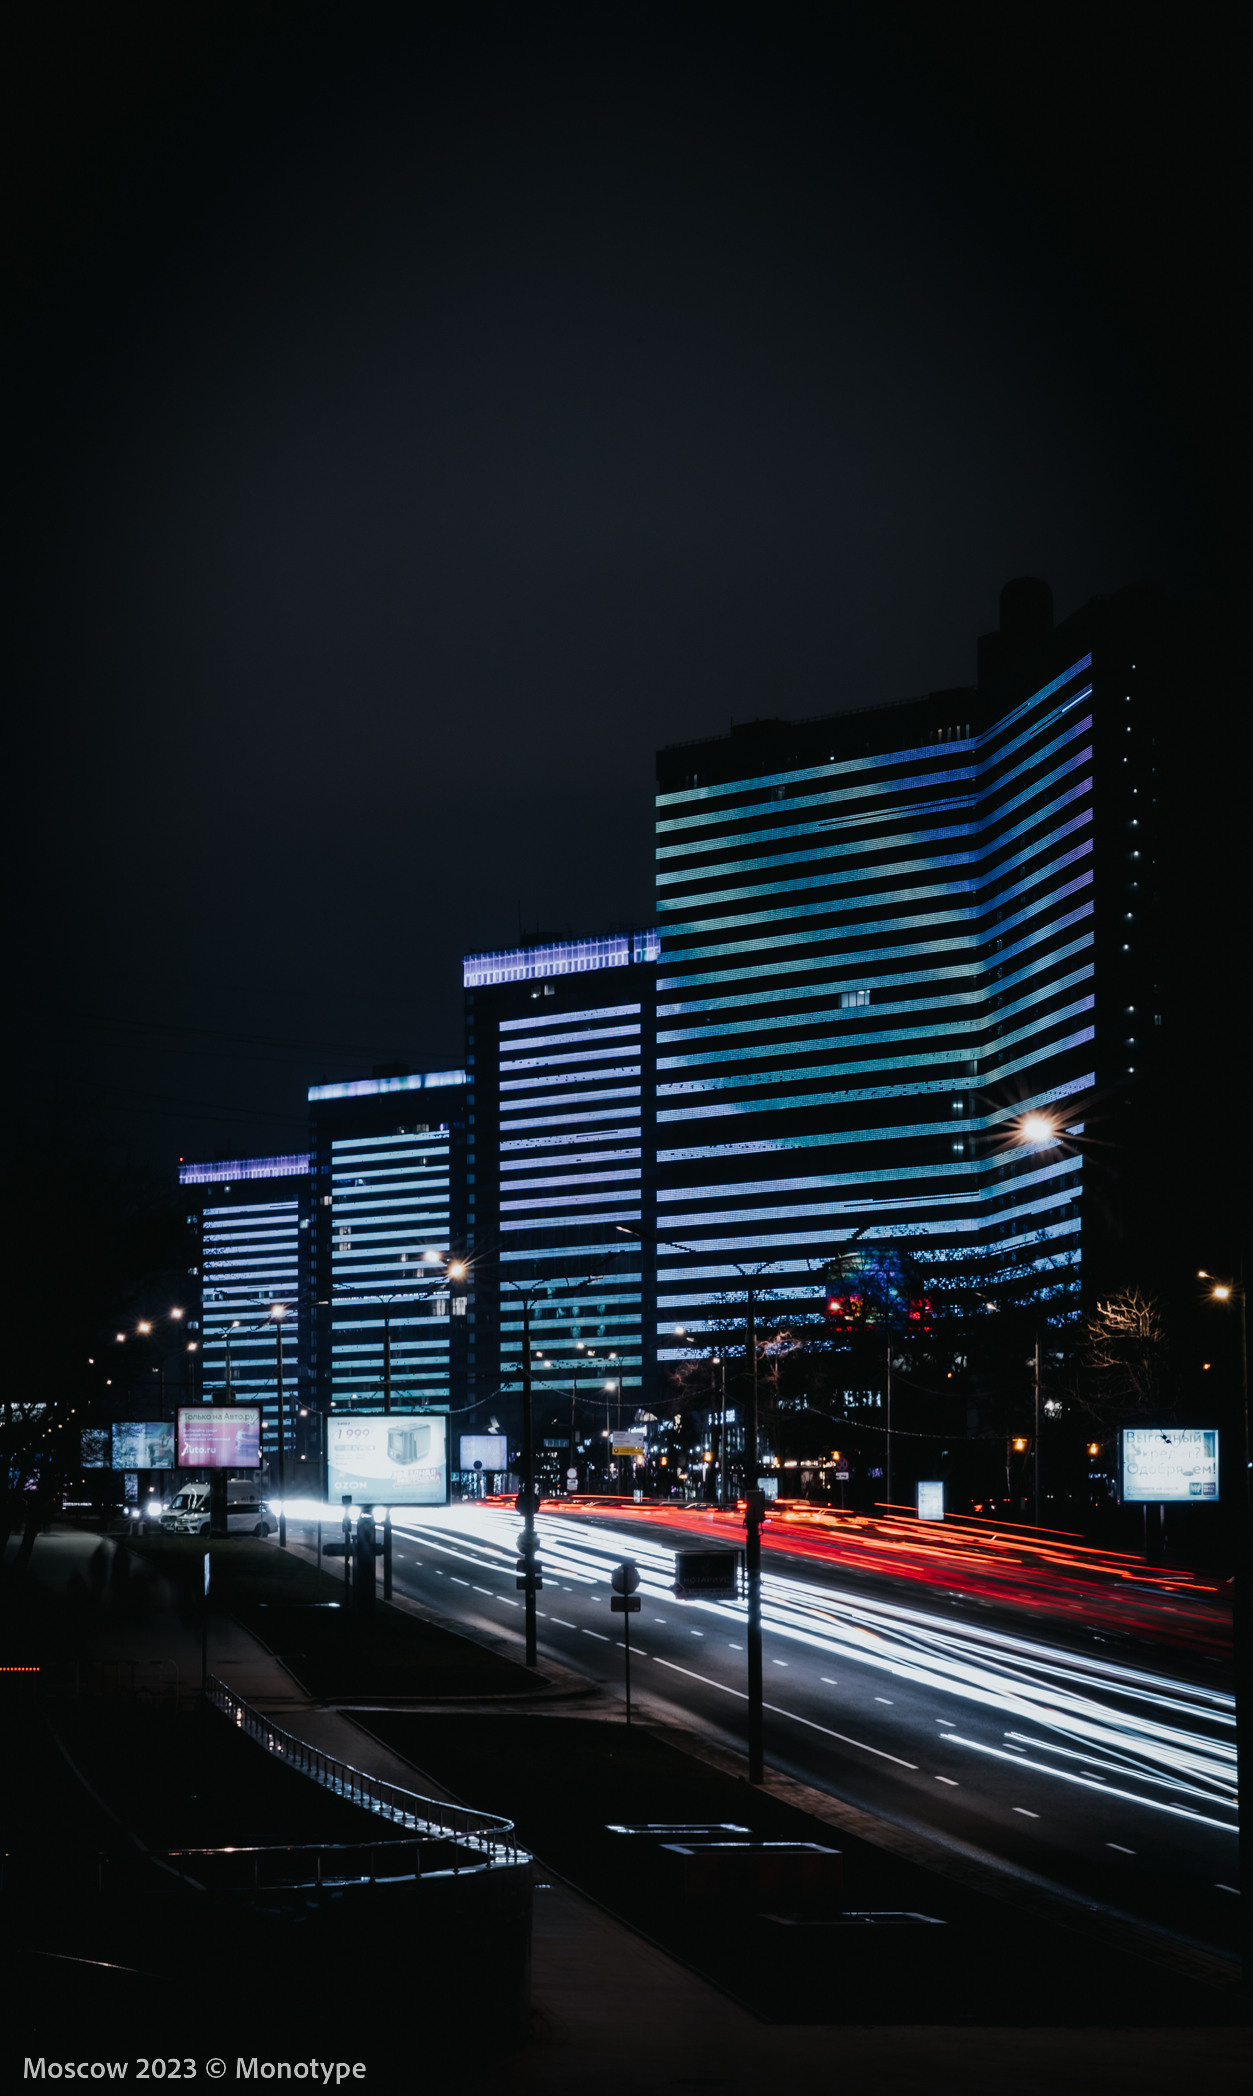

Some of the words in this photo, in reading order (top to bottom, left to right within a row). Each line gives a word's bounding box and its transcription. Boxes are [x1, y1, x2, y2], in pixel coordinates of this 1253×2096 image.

[184, 1412, 212, 1421] Только
[224, 1412, 255, 1421] Авто.ру
[346, 1428, 370, 1439] 999
[1126, 1431, 1202, 1444] Выгодный
[1142, 1446, 1201, 1459] кредт?
[334, 1481, 367, 1490] OZON
[683, 1577, 731, 1585] НОТАРИУС
